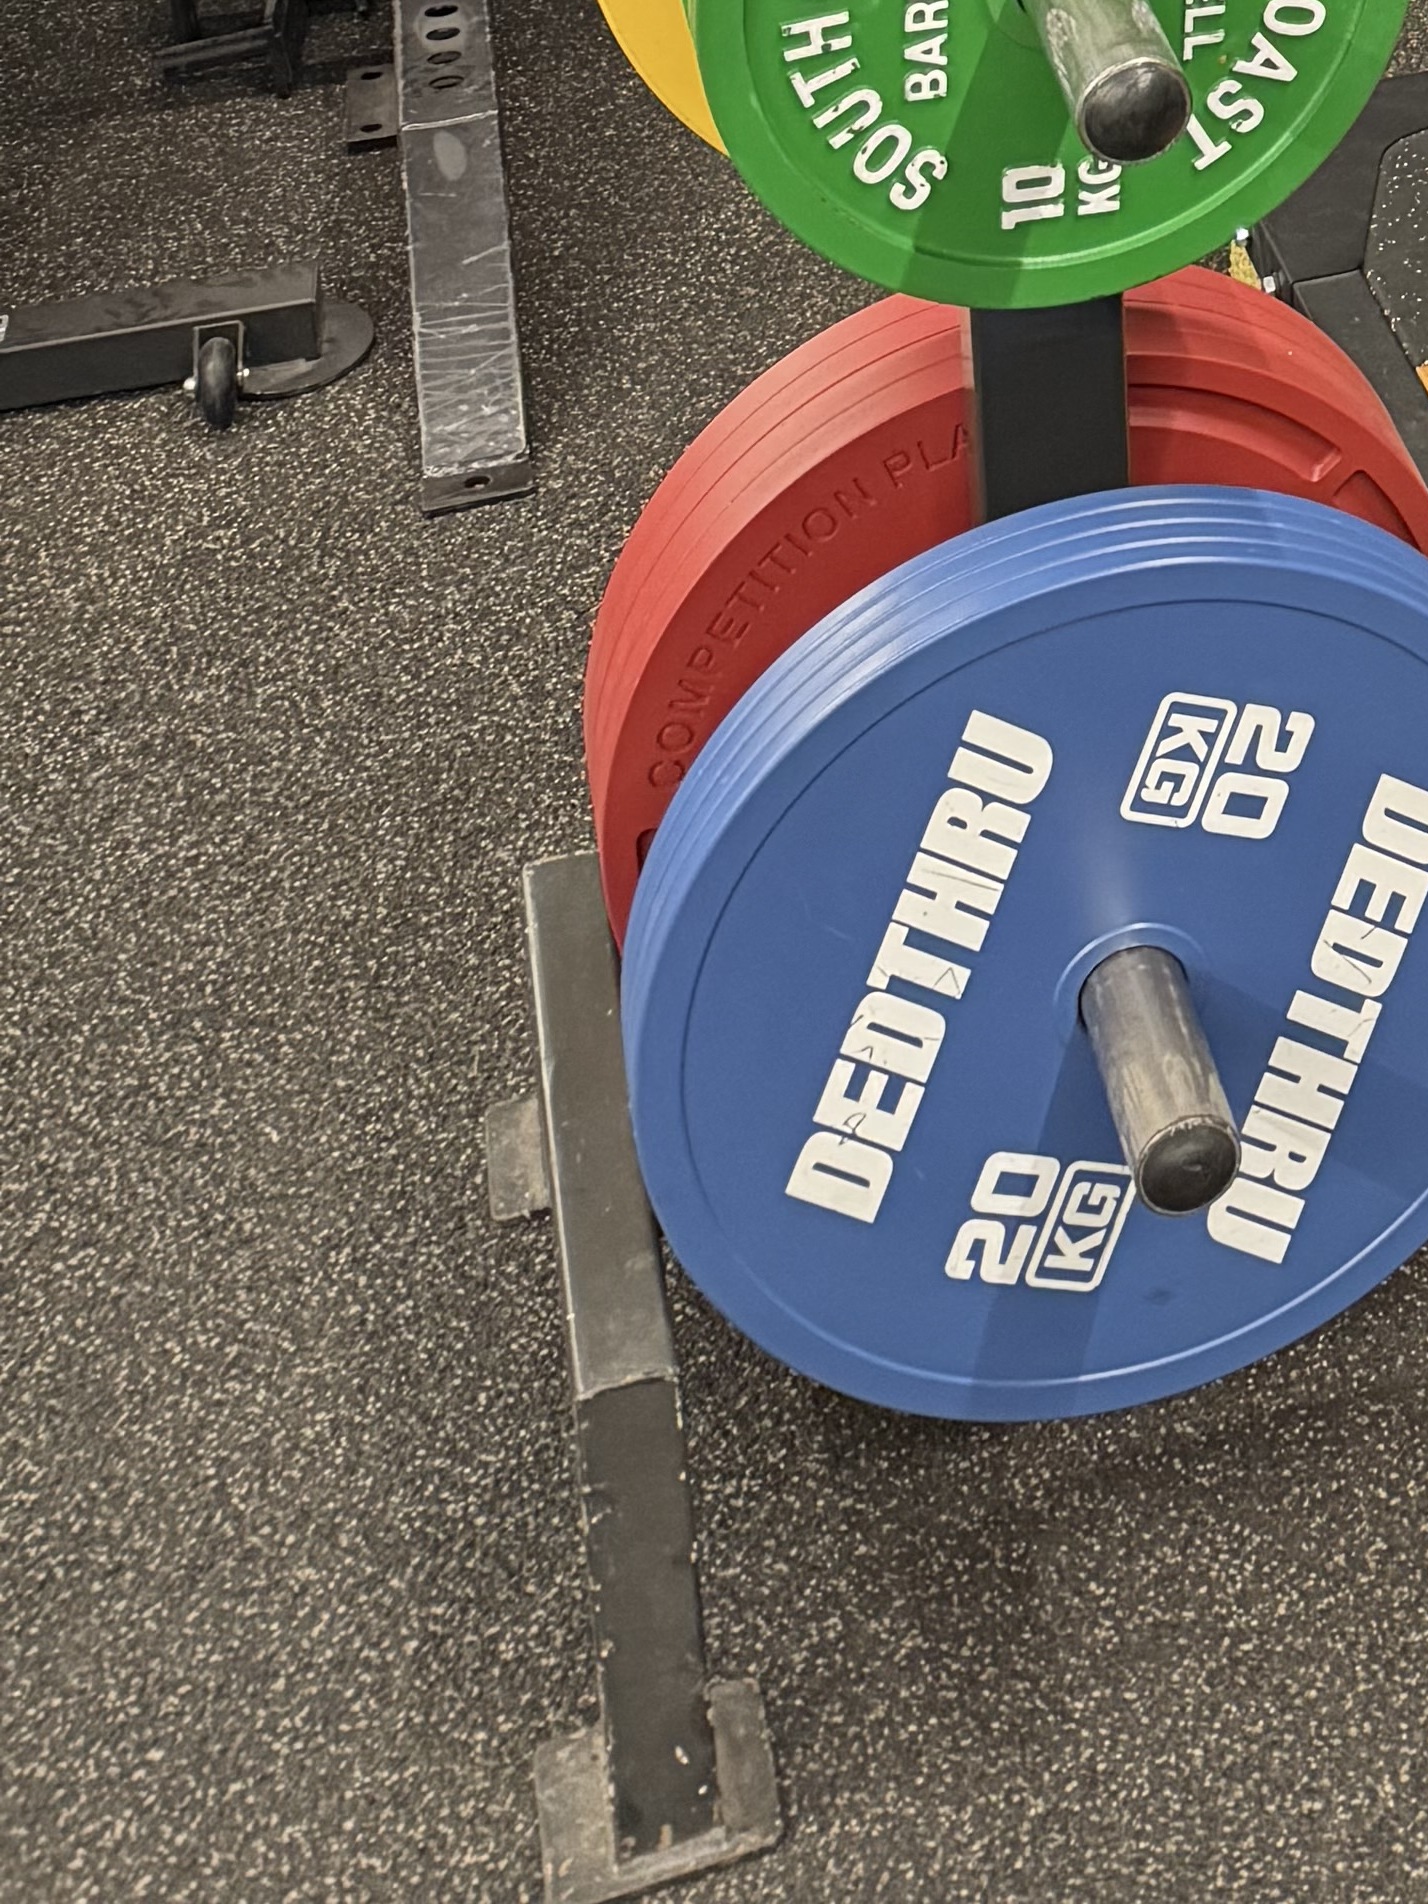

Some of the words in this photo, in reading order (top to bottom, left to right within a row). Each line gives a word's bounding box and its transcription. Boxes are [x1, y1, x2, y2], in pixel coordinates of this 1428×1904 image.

[779, 8, 949, 211] SOUTH
[1000, 161, 1065, 231] 10
[647, 476, 879, 789] COMPETITION
[1139, 711, 1218, 808] KG
[1200, 702, 1317, 841] 20
[784, 708, 1054, 1225] DEDTHRU
[944, 1150, 1062, 1286] 20
[1043, 1176, 1123, 1271] KG
